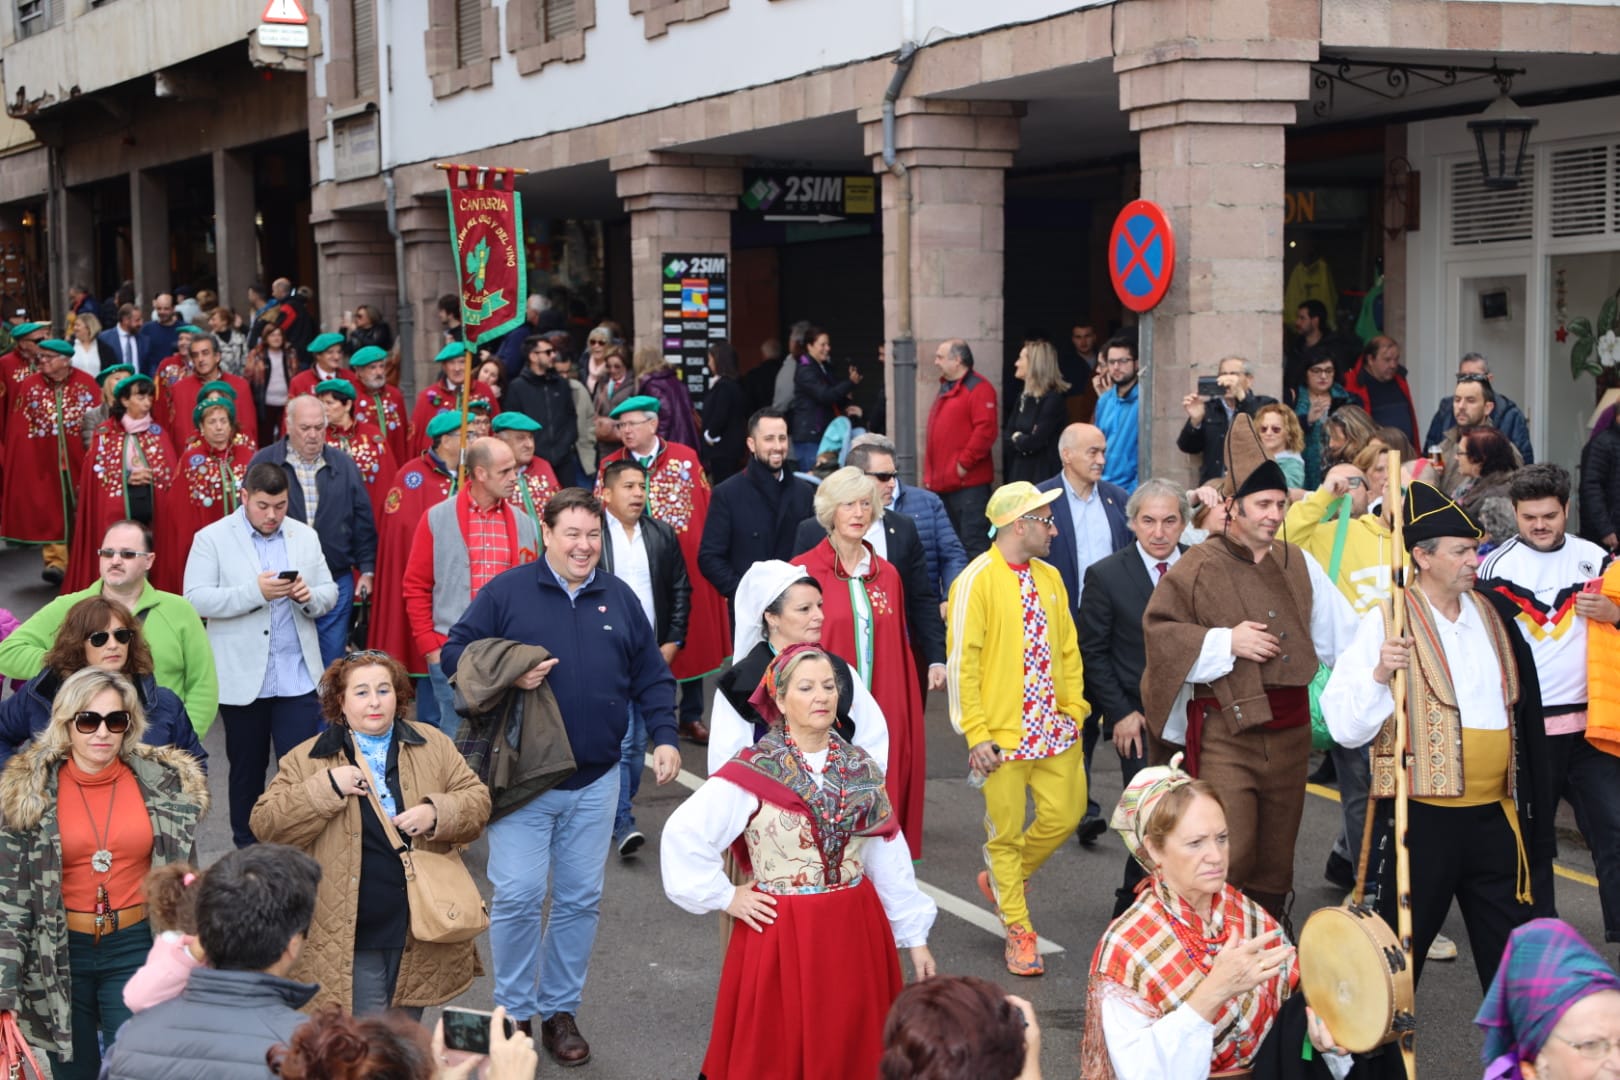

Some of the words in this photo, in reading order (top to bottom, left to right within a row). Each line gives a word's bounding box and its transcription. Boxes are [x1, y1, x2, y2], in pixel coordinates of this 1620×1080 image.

[784, 176, 842, 202] 2SIM
[495, 226, 509, 245] DEL
[506, 245, 516, 267] VINO
[690, 257, 726, 273] 2SIM
